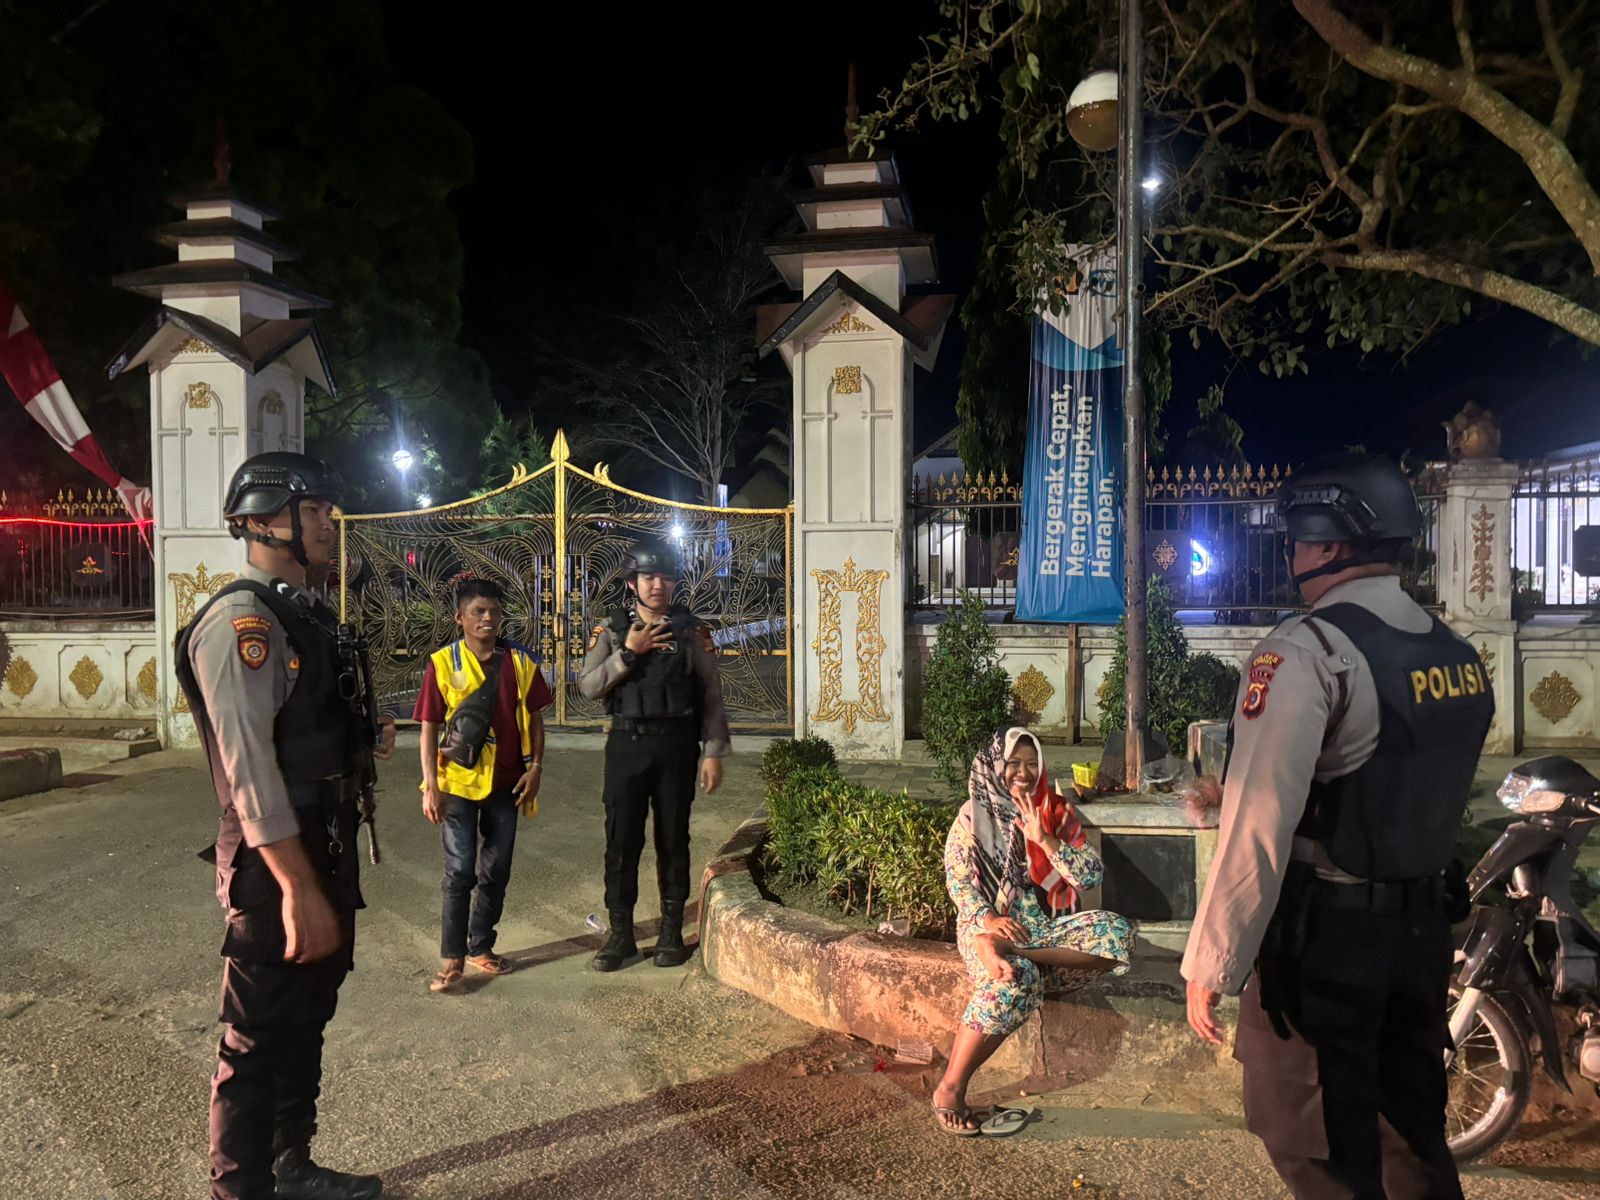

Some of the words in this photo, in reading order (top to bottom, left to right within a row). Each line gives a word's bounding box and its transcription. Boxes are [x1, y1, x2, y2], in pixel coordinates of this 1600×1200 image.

[1046, 383, 1073, 461] Cepat,
[1040, 467, 1067, 576] Bergerak
[1065, 396, 1096, 577] Menghidupkan
[1091, 471, 1116, 578] Harapan.
[1410, 662, 1486, 704] POLISI
